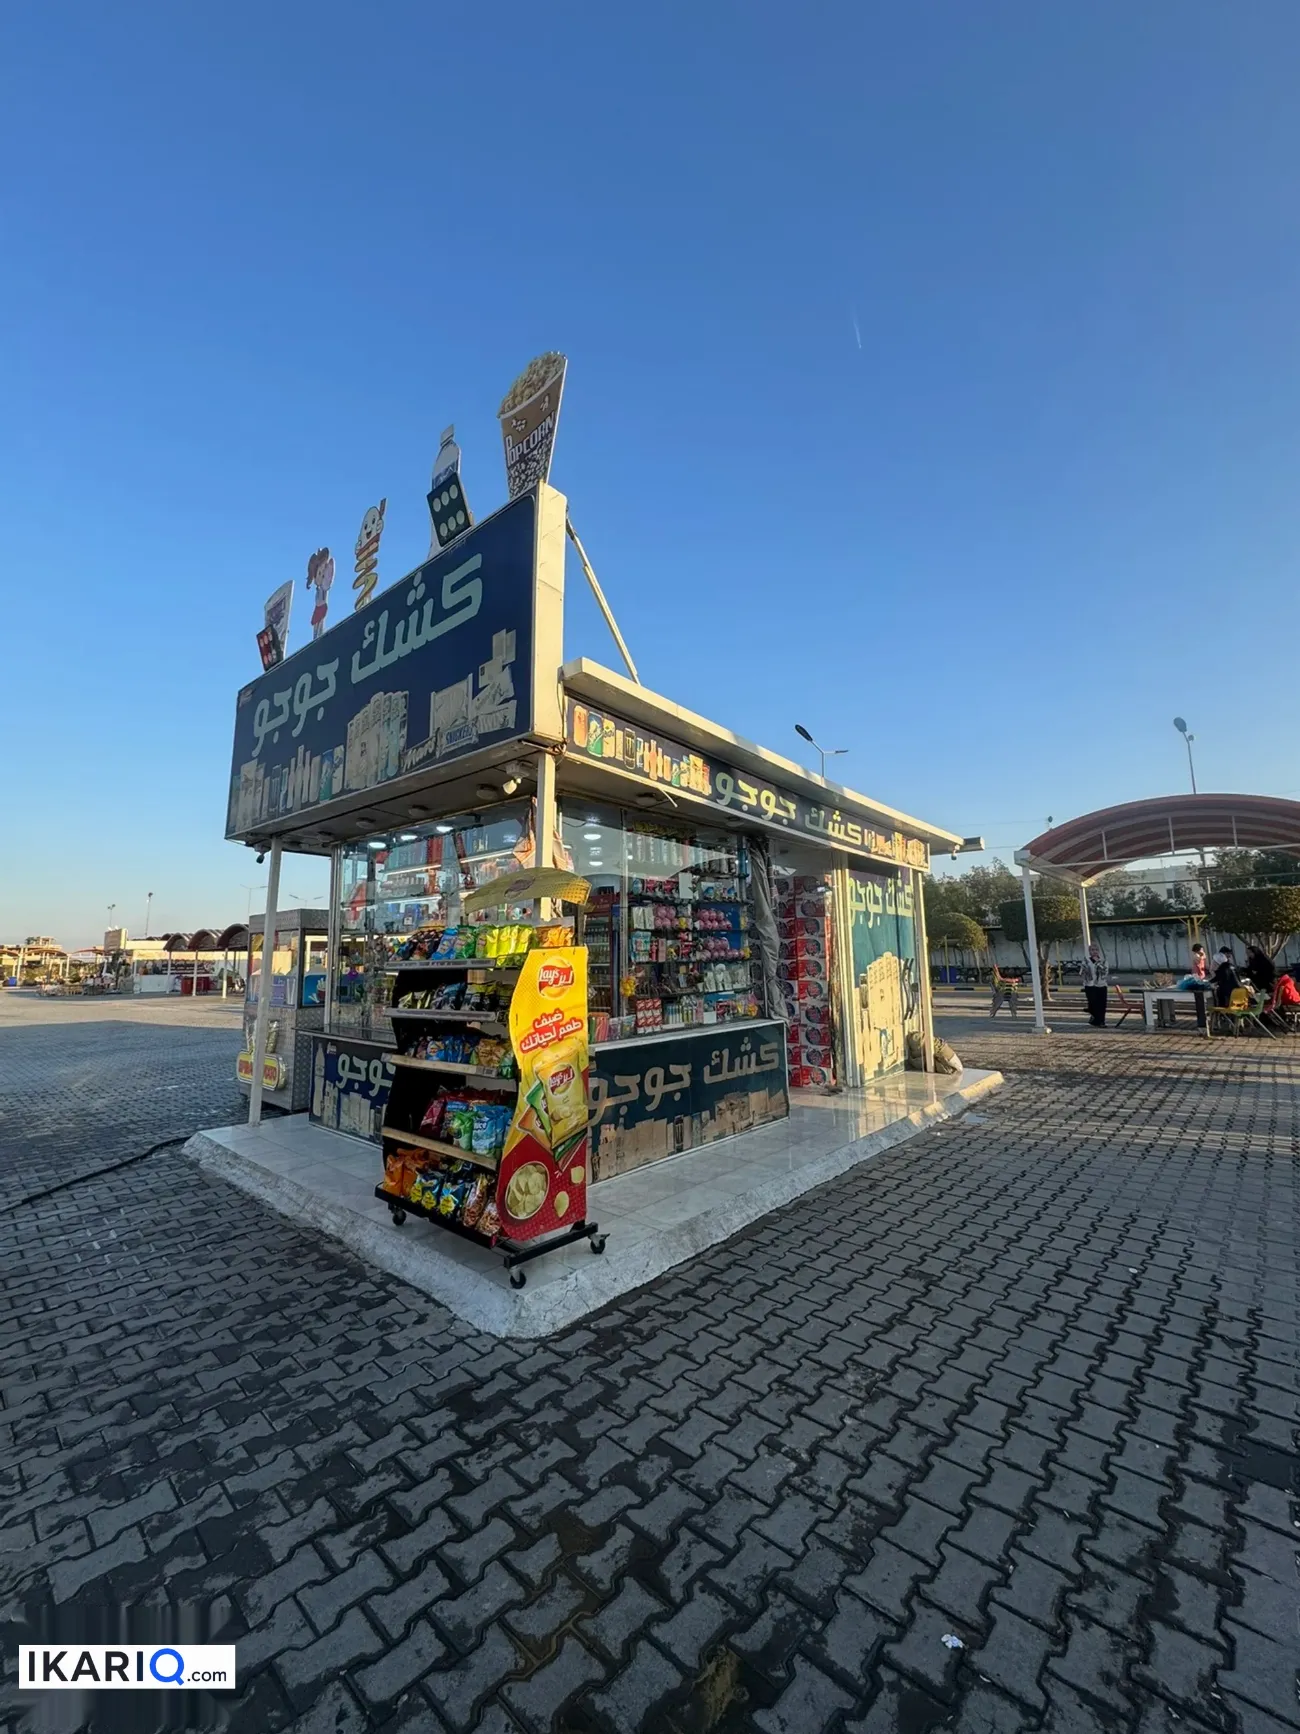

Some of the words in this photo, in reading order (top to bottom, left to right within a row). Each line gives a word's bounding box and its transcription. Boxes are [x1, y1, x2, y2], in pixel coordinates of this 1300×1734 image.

[505, 411, 555, 467] POPCORN
[252, 657, 339, 757] جوجو
[715, 772, 797, 825] جوجو
[804, 806, 862, 845] كشك
[559, 1019, 582, 1038] طعم
[703, 1036, 780, 1084] كشك
